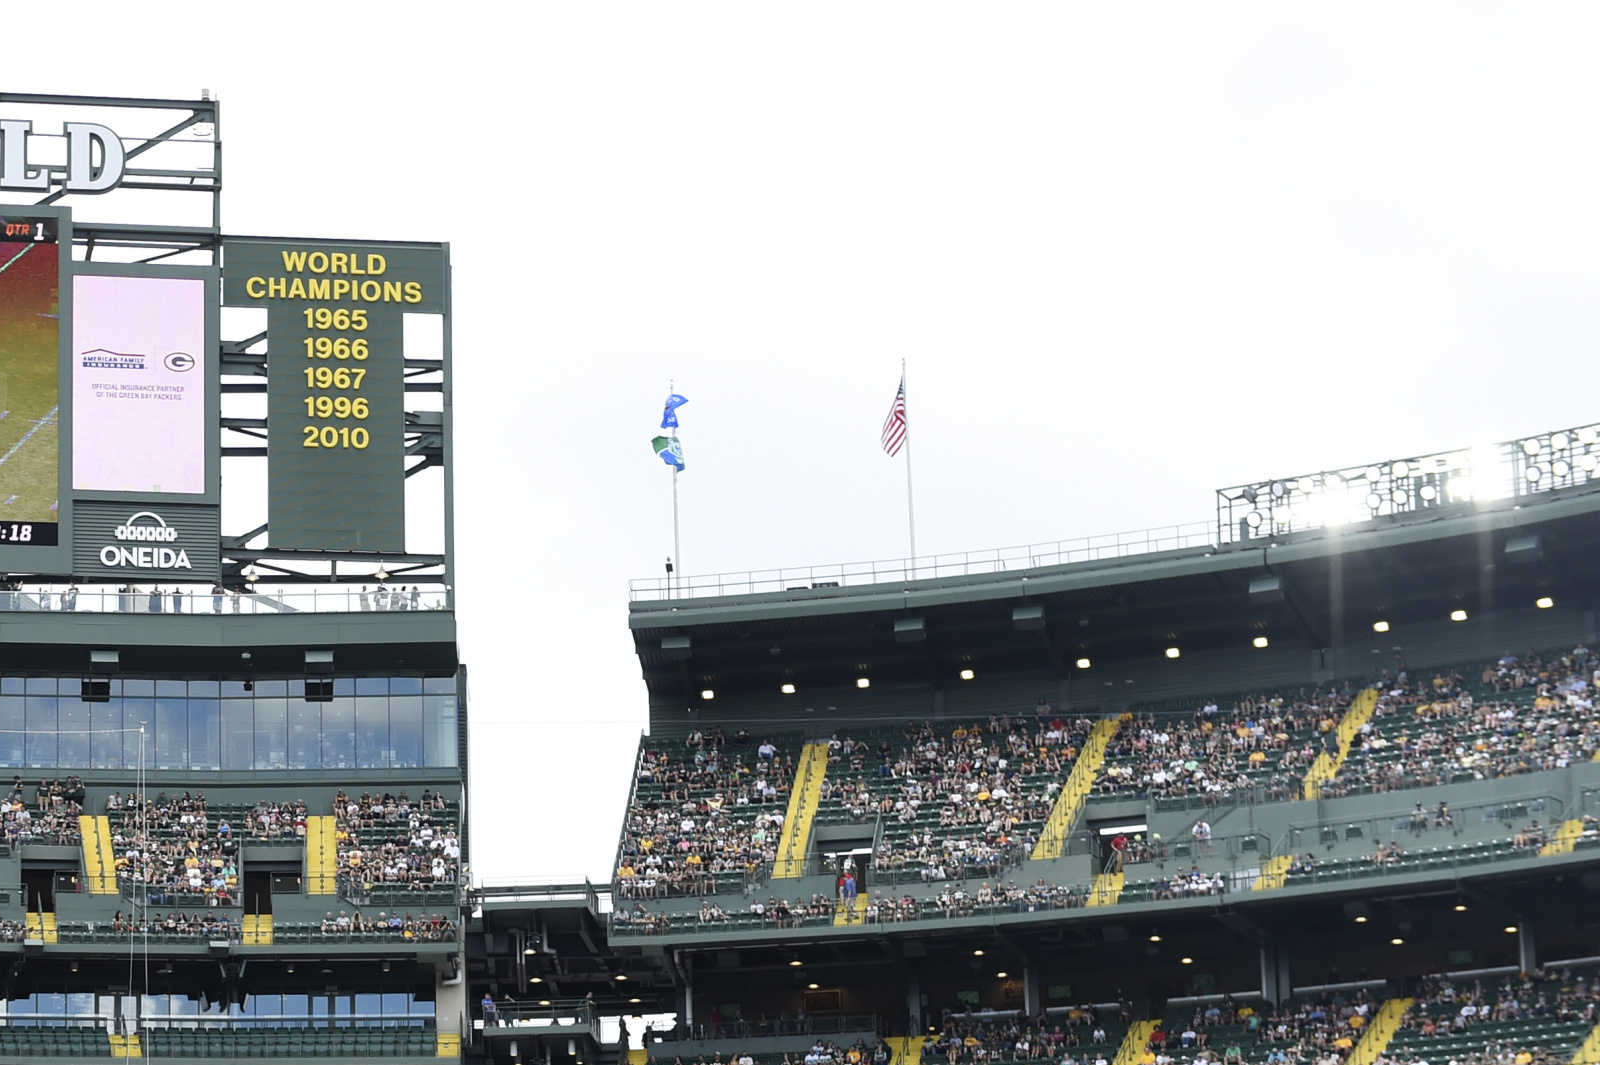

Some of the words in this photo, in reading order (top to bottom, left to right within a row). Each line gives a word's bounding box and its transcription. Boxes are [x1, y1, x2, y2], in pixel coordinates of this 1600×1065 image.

[6, 223, 30, 237] QTR
[34, 223, 44, 240] 1
[282, 250, 386, 276] WORLD
[246, 276, 422, 303] CHAMPIONS
[304, 307, 368, 331] 1965
[304, 337, 369, 360] 1966
[120, 384, 156, 392] INSURANCE
[304, 367, 366, 390] 1967
[118, 392, 138, 400] GREEN
[304, 396, 370, 420] 1996
[303, 426, 370, 449] 2010
[100, 546, 192, 569] ONEIDA
